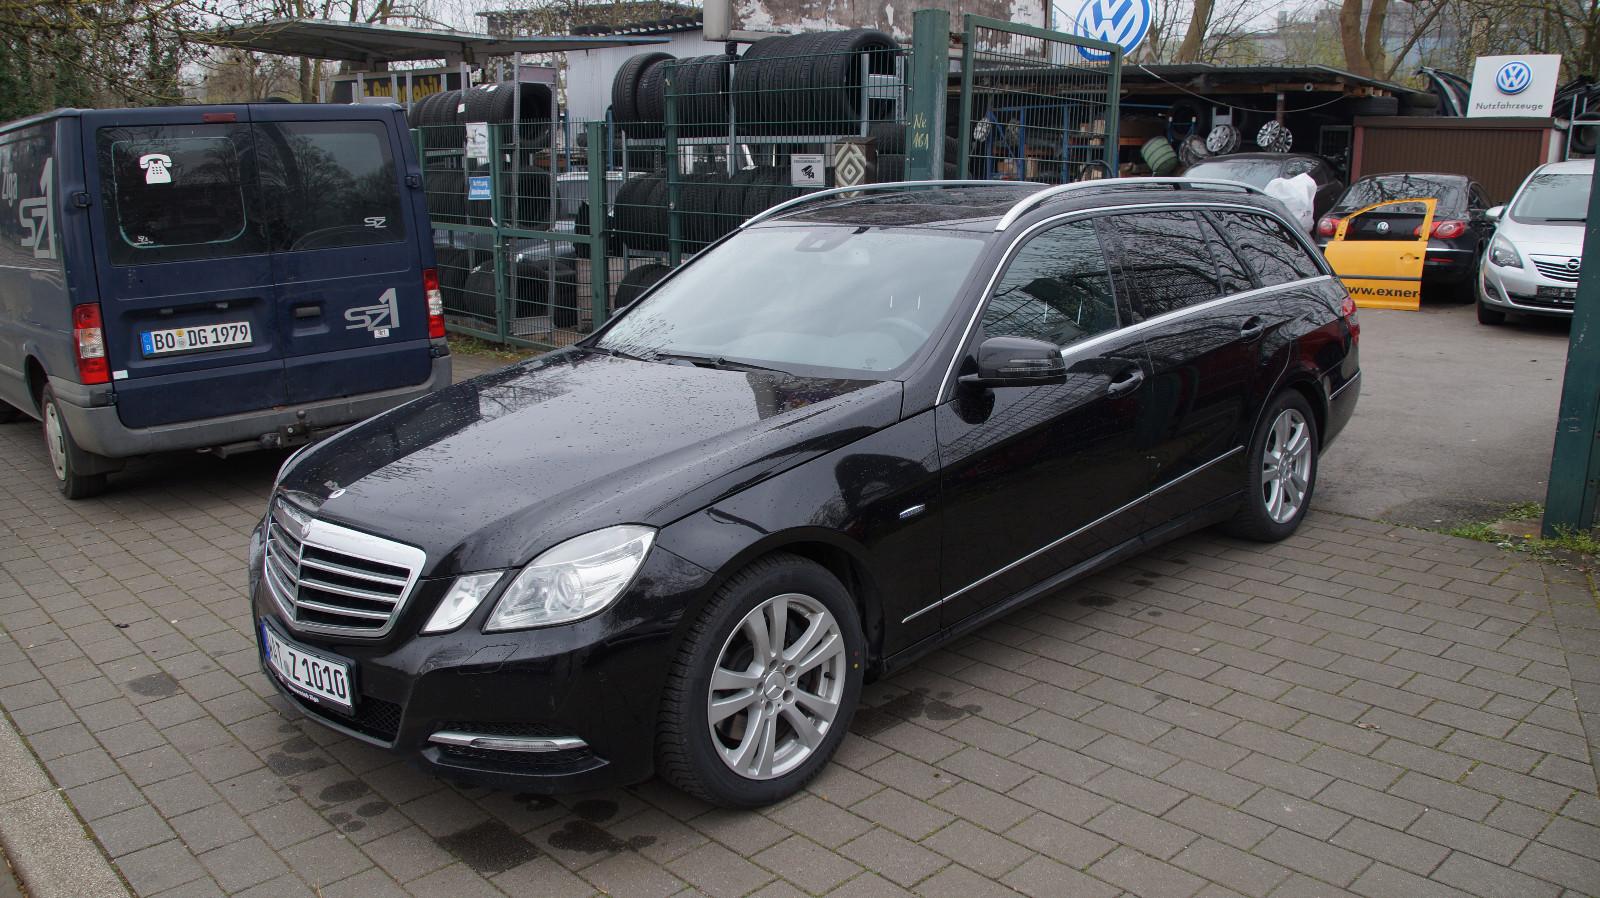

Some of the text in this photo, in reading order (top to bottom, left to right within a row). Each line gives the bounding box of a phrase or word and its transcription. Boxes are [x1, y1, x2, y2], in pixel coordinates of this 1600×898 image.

[1475, 102, 1544, 111] Nutzfahrzeuge
[363, 216, 388, 229] SZ
[153, 332, 176, 351] BO
[187, 328, 208, 347] DG
[211, 324, 249, 346] 1979
[288, 651, 301, 681] Z
[302, 658, 347, 700] 1010
